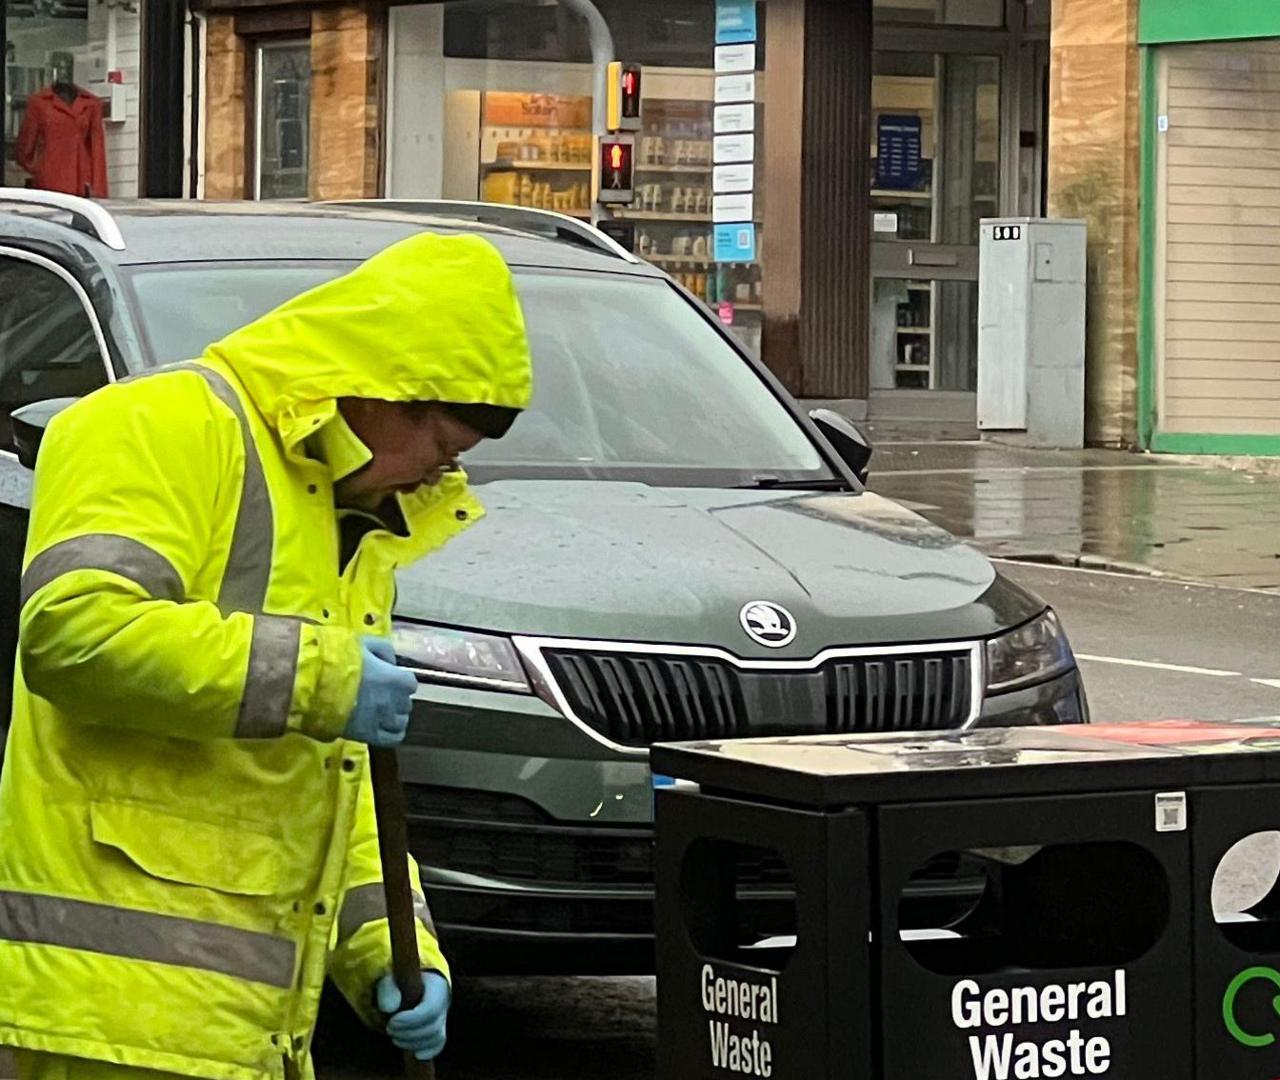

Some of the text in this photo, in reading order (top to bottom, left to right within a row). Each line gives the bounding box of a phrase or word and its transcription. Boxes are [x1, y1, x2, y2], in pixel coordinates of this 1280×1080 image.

[701, 964, 779, 1024] General
[951, 969, 1126, 1029] General
[709, 1018, 773, 1078] Waste
